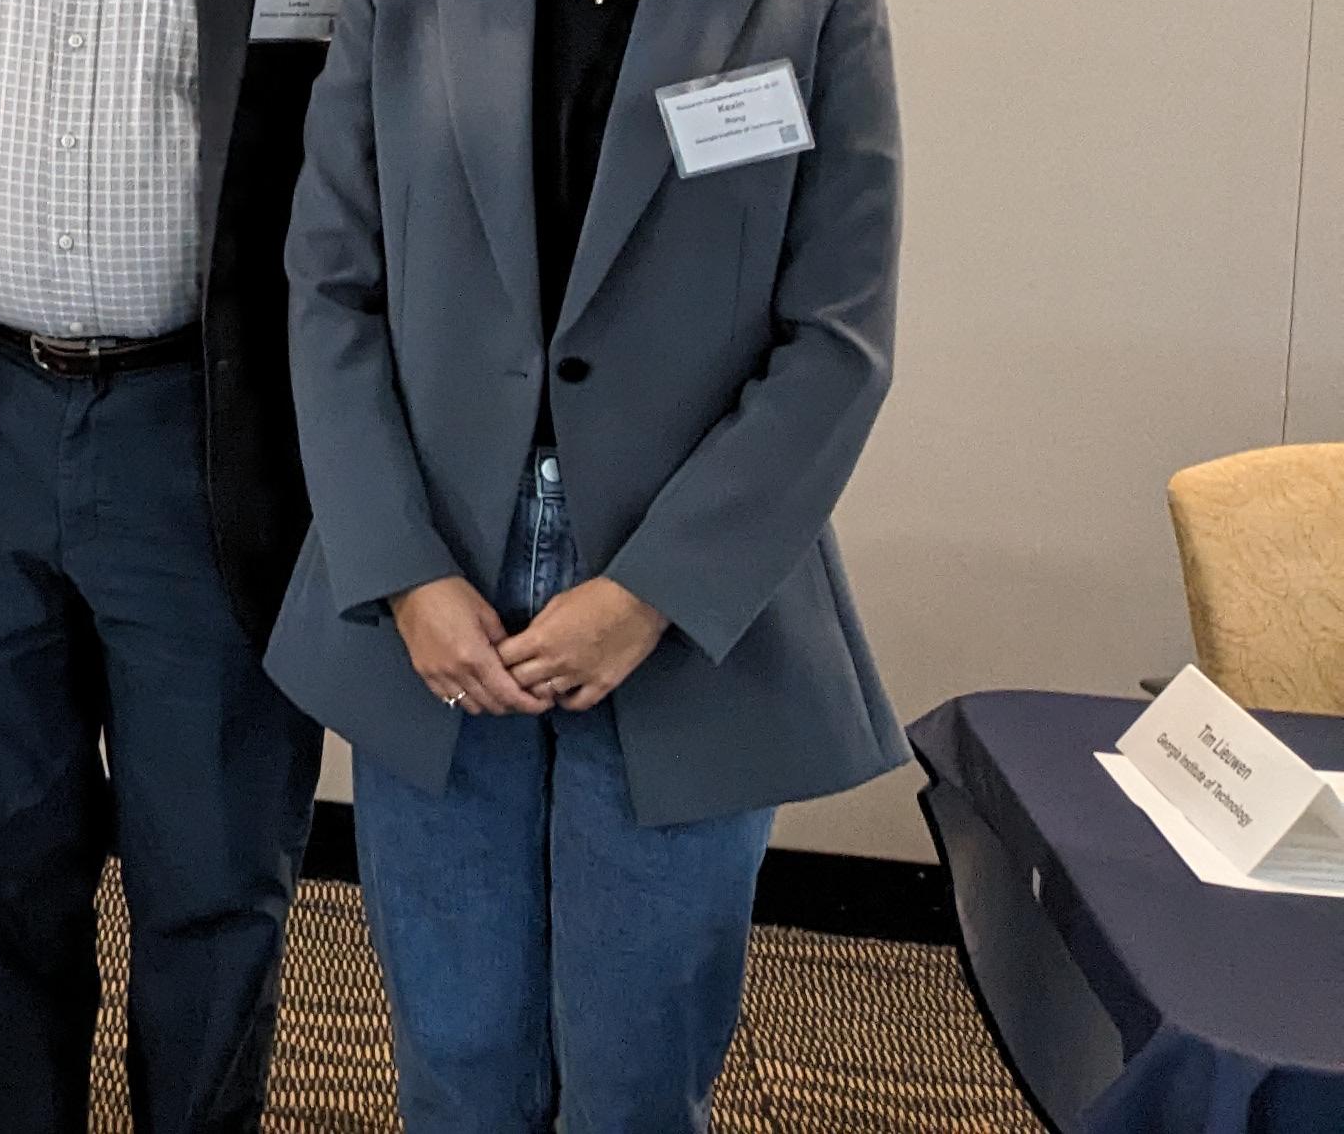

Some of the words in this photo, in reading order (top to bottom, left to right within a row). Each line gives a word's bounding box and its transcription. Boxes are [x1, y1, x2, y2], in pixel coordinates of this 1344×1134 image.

[717, 100, 745, 113] Kexin
[1156, 732, 1182, 761] Georgia
[1180, 751, 1206, 783] Institute
[1203, 778, 1216, 791] of
[1211, 783, 1253, 828] Technology
[1197, 723, 1216, 748] Tim
[1213, 738, 1253, 781] Lieuwen
